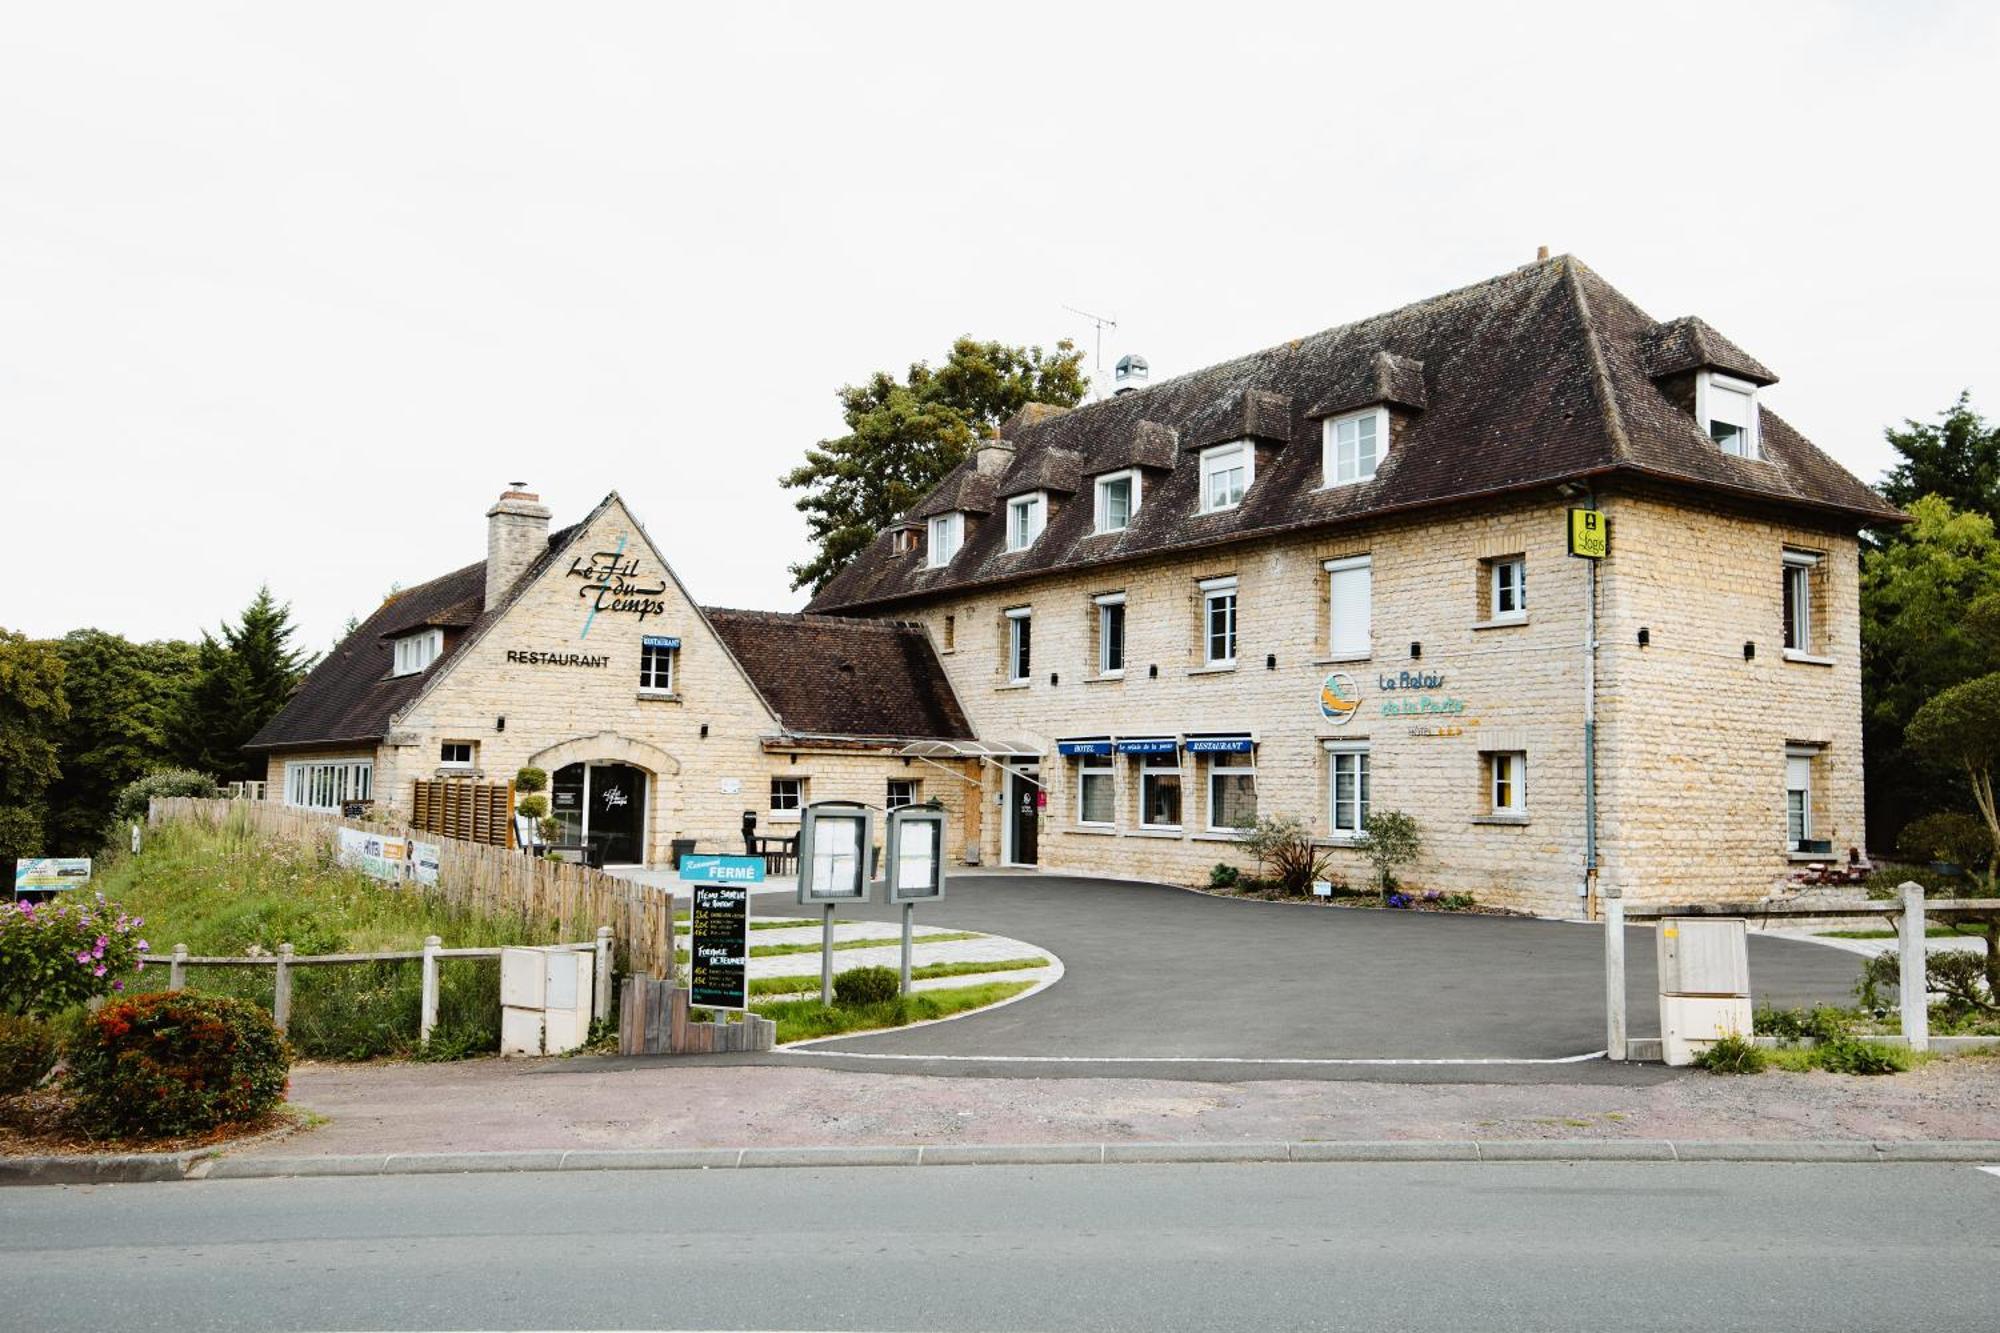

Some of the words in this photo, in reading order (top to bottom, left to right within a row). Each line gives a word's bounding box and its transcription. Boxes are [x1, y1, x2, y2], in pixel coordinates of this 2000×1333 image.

[1579, 531, 1605, 555] Logis
[566, 556, 593, 579] Le
[591, 551, 640, 582] Fil
[579, 584, 665, 622] Temps
[507, 650, 610, 668] RESTAURANT
[1379, 673, 1396, 691] Le
[1400, 670, 1445, 689] Relais
[1382, 701, 1399, 715] de
[1420, 696, 1464, 714] Poste
[1192, 742, 1243, 750] RESTAURANT
[709, 865, 755, 879] FERMÉ
